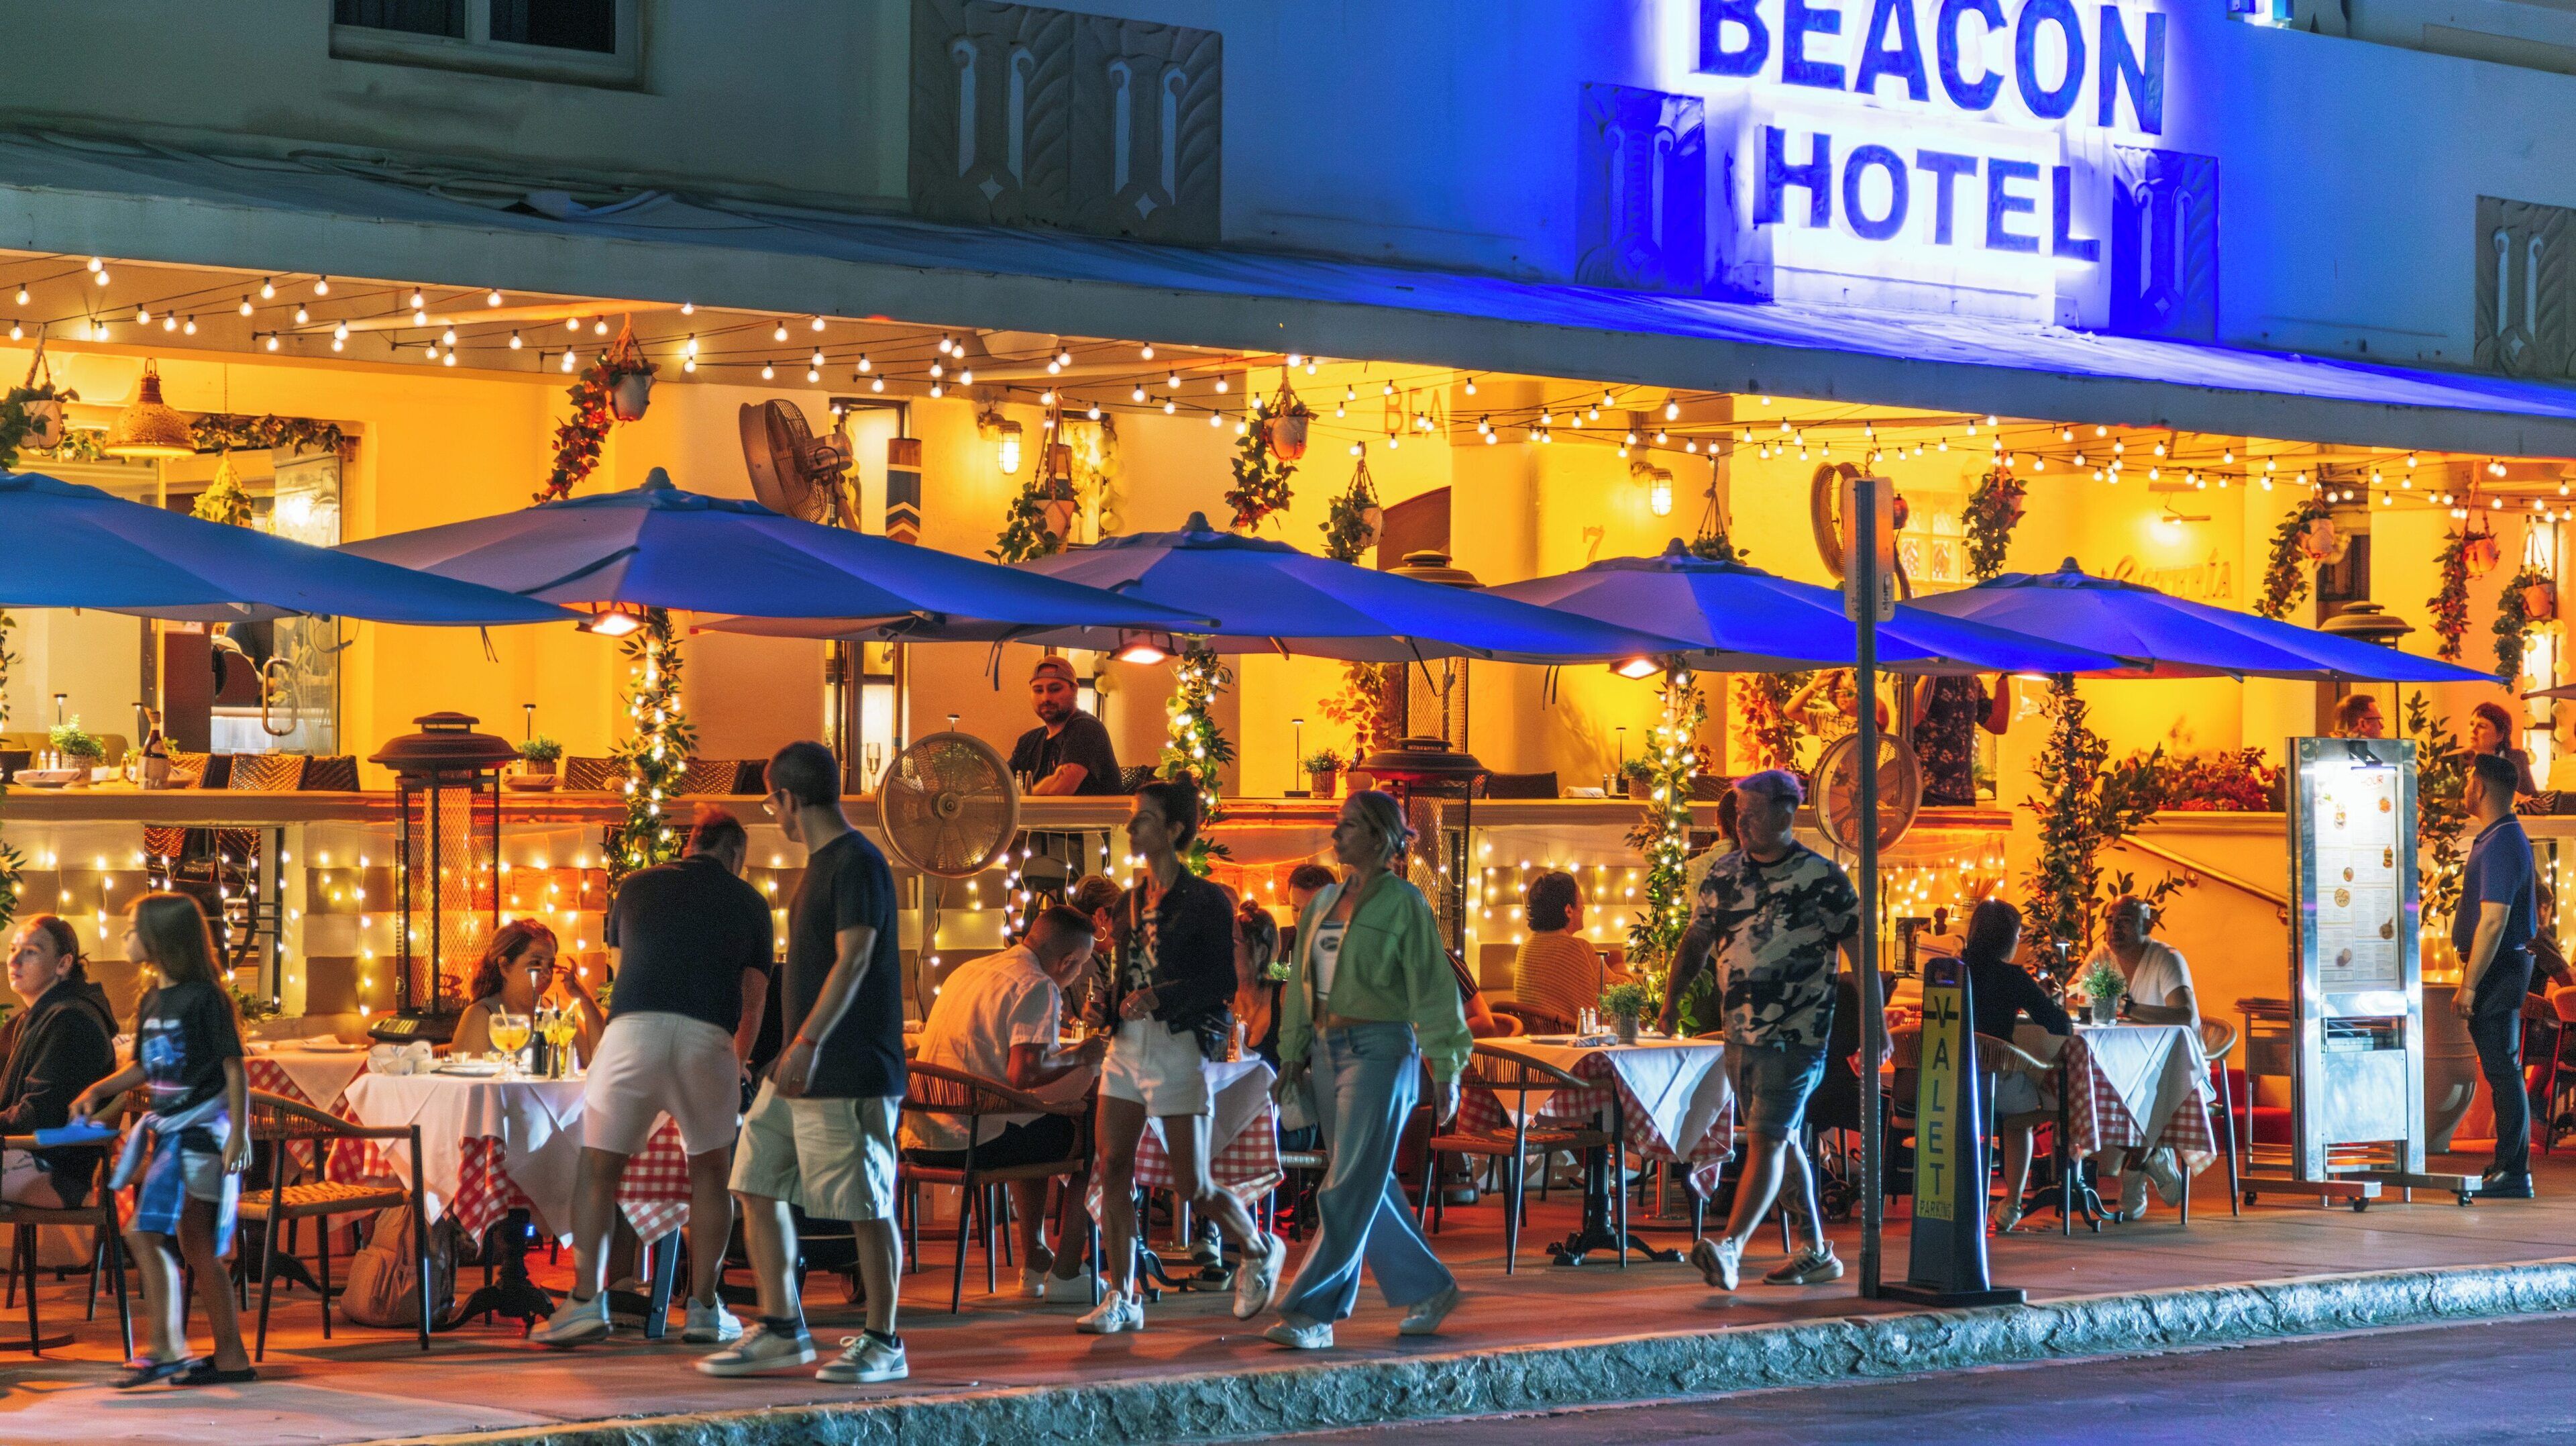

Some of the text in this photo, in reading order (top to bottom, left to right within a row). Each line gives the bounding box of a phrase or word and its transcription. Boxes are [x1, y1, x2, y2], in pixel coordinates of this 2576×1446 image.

[1699, 0, 2165, 136] BEACON
[1753, 125, 2100, 262] HOTEL
[1927, 996, 1951, 1196] VALET
